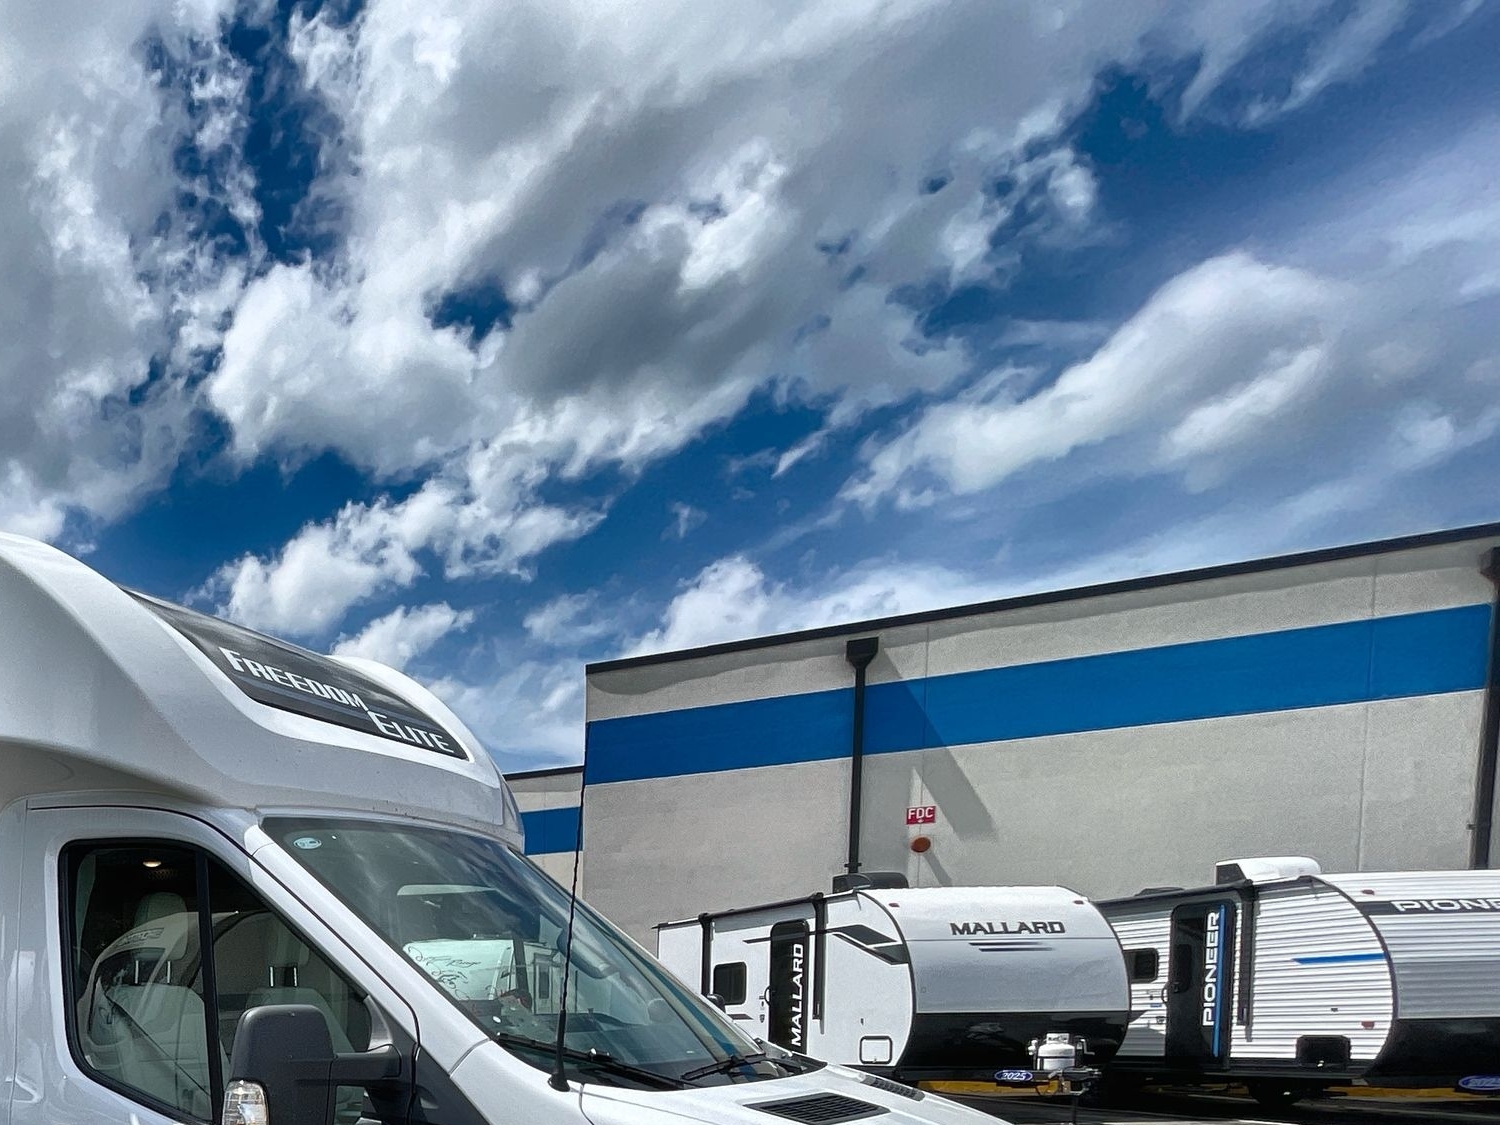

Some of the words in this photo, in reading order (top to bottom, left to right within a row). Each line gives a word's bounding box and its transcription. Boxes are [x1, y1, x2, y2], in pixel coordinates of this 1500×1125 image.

[218, 646, 369, 712] FREEDOM
[366, 709, 454, 753] ELITE
[907, 806, 934, 820] FDC
[949, 921, 1066, 935] MALLARD
[1202, 910, 1220, 1026] PIONEER
[791, 943, 804, 1047] MALLARD
[1001, 1071, 1027, 1080] 2025
